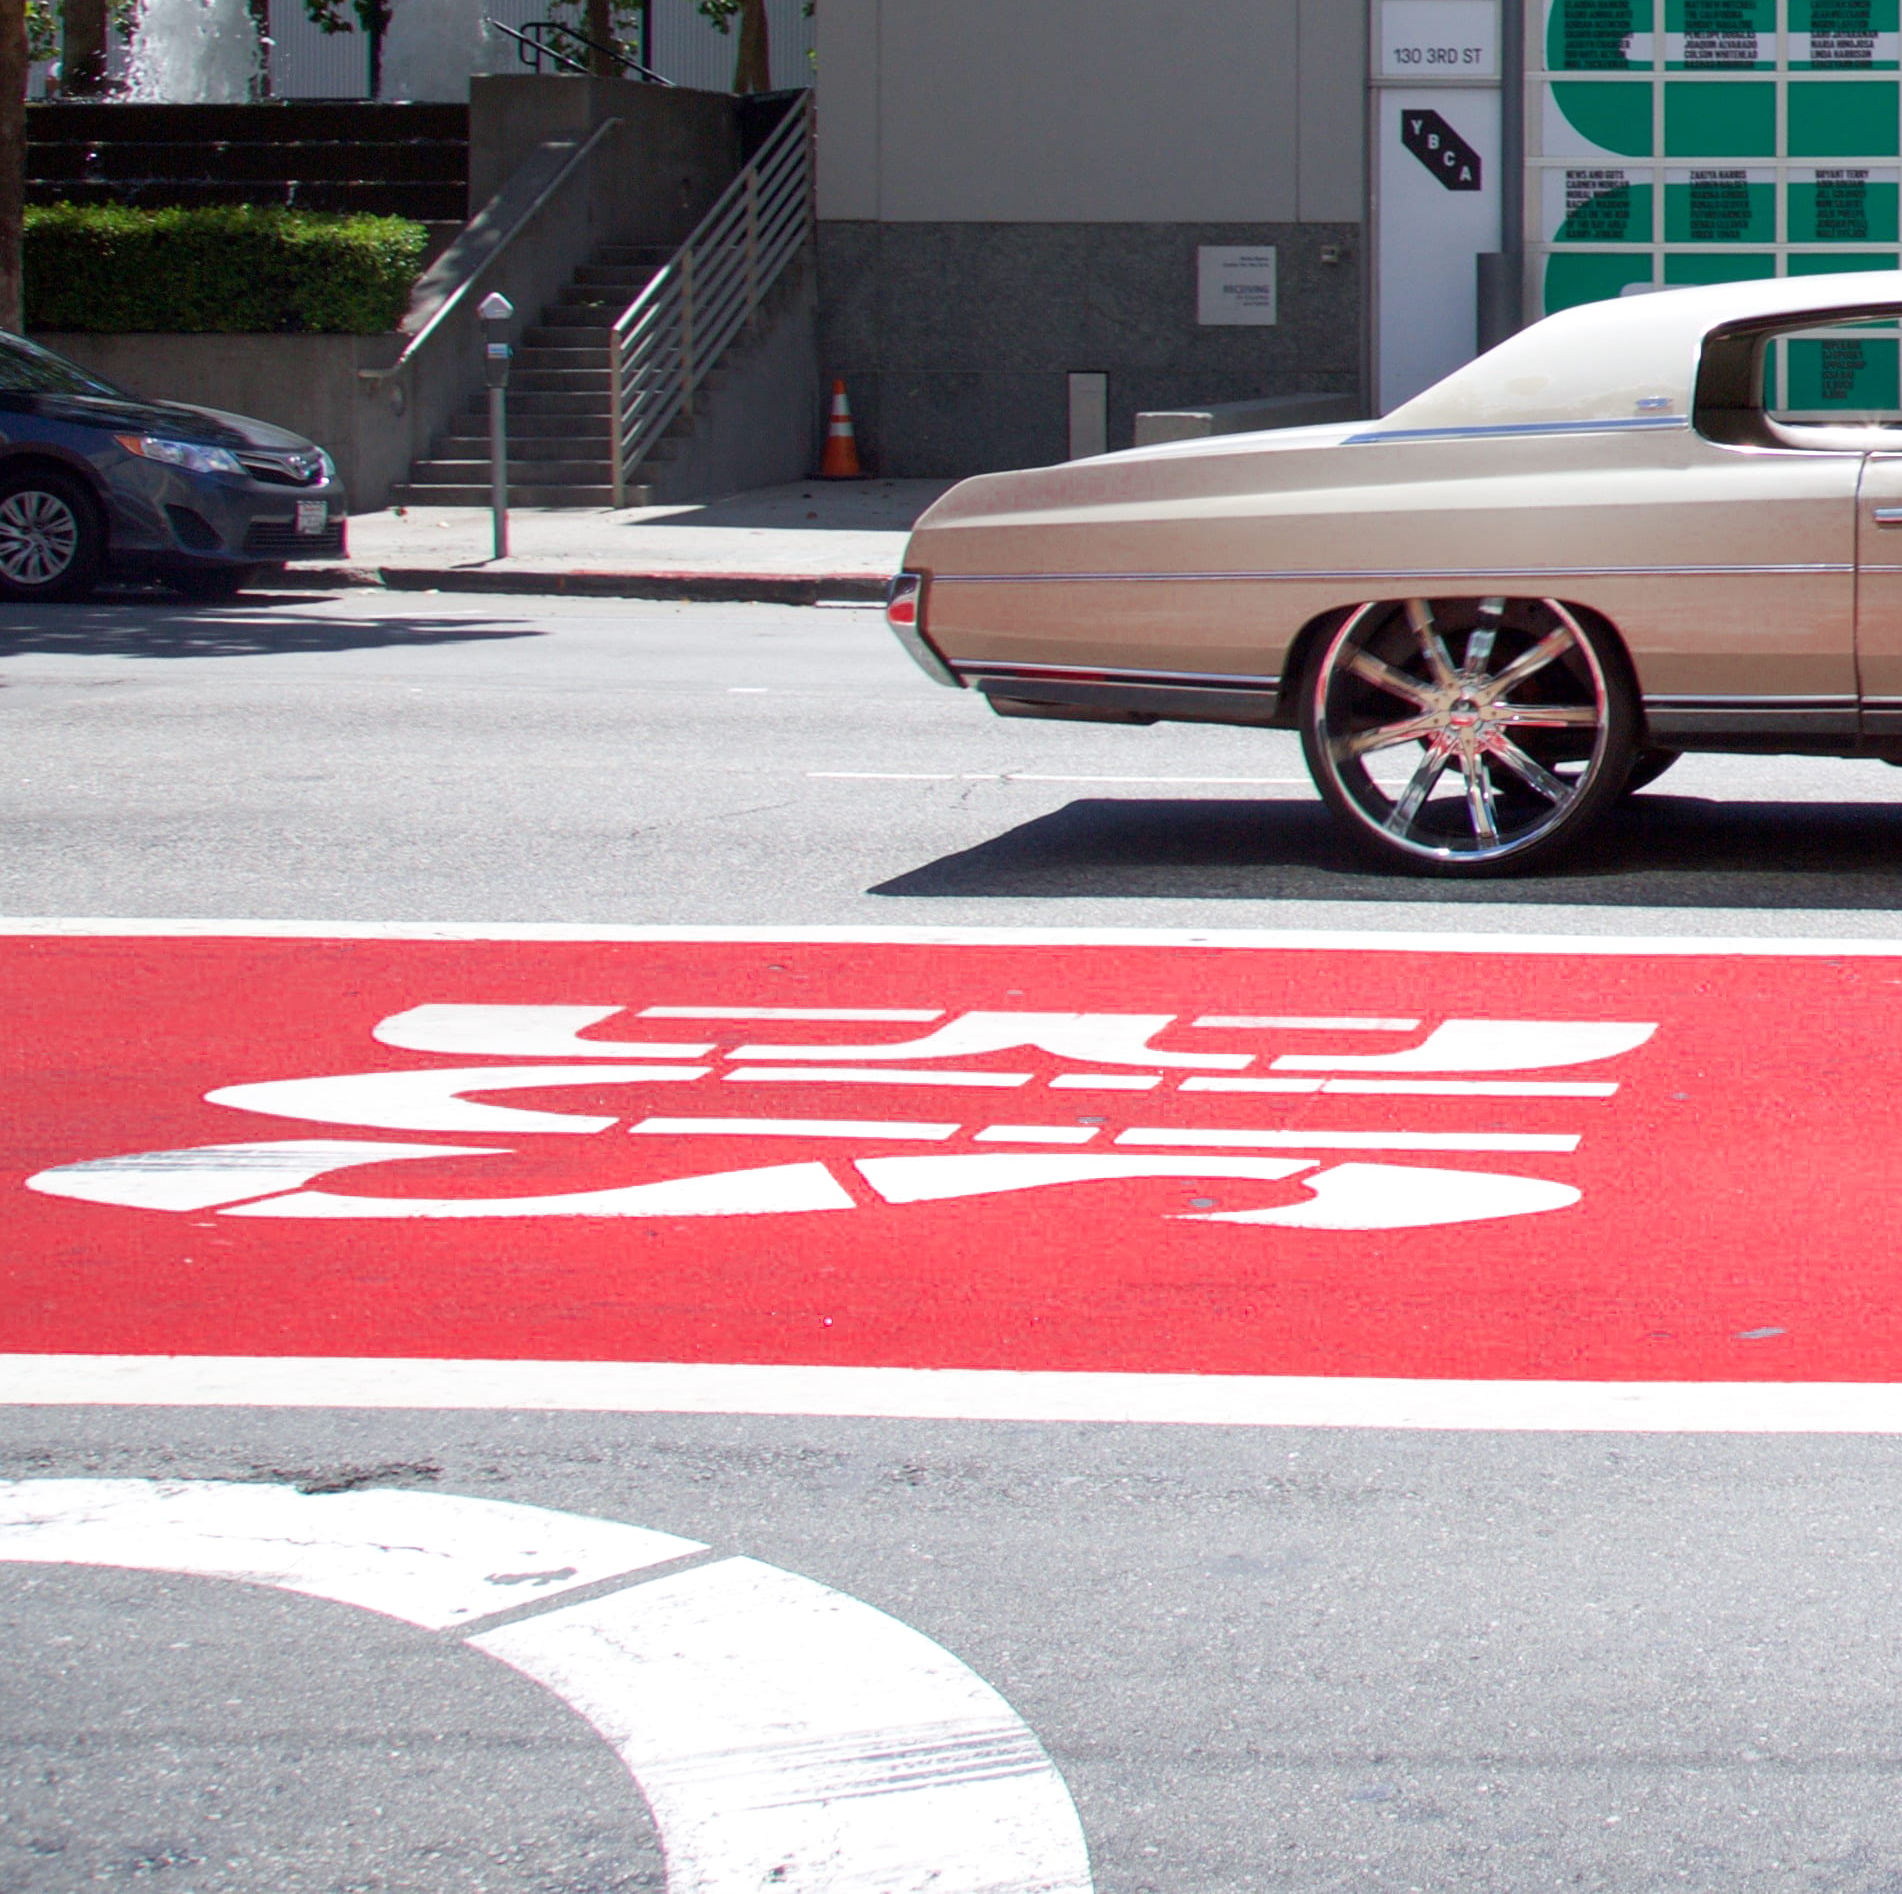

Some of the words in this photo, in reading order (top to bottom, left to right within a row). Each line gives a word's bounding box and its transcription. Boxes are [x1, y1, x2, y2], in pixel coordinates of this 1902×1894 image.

[1394, 48, 1422, 64] 130
[1426, 48, 1458, 64] 3RD
[1463, 48, 1482, 64] ST
[24, 1002, 1658, 1232] BUS
